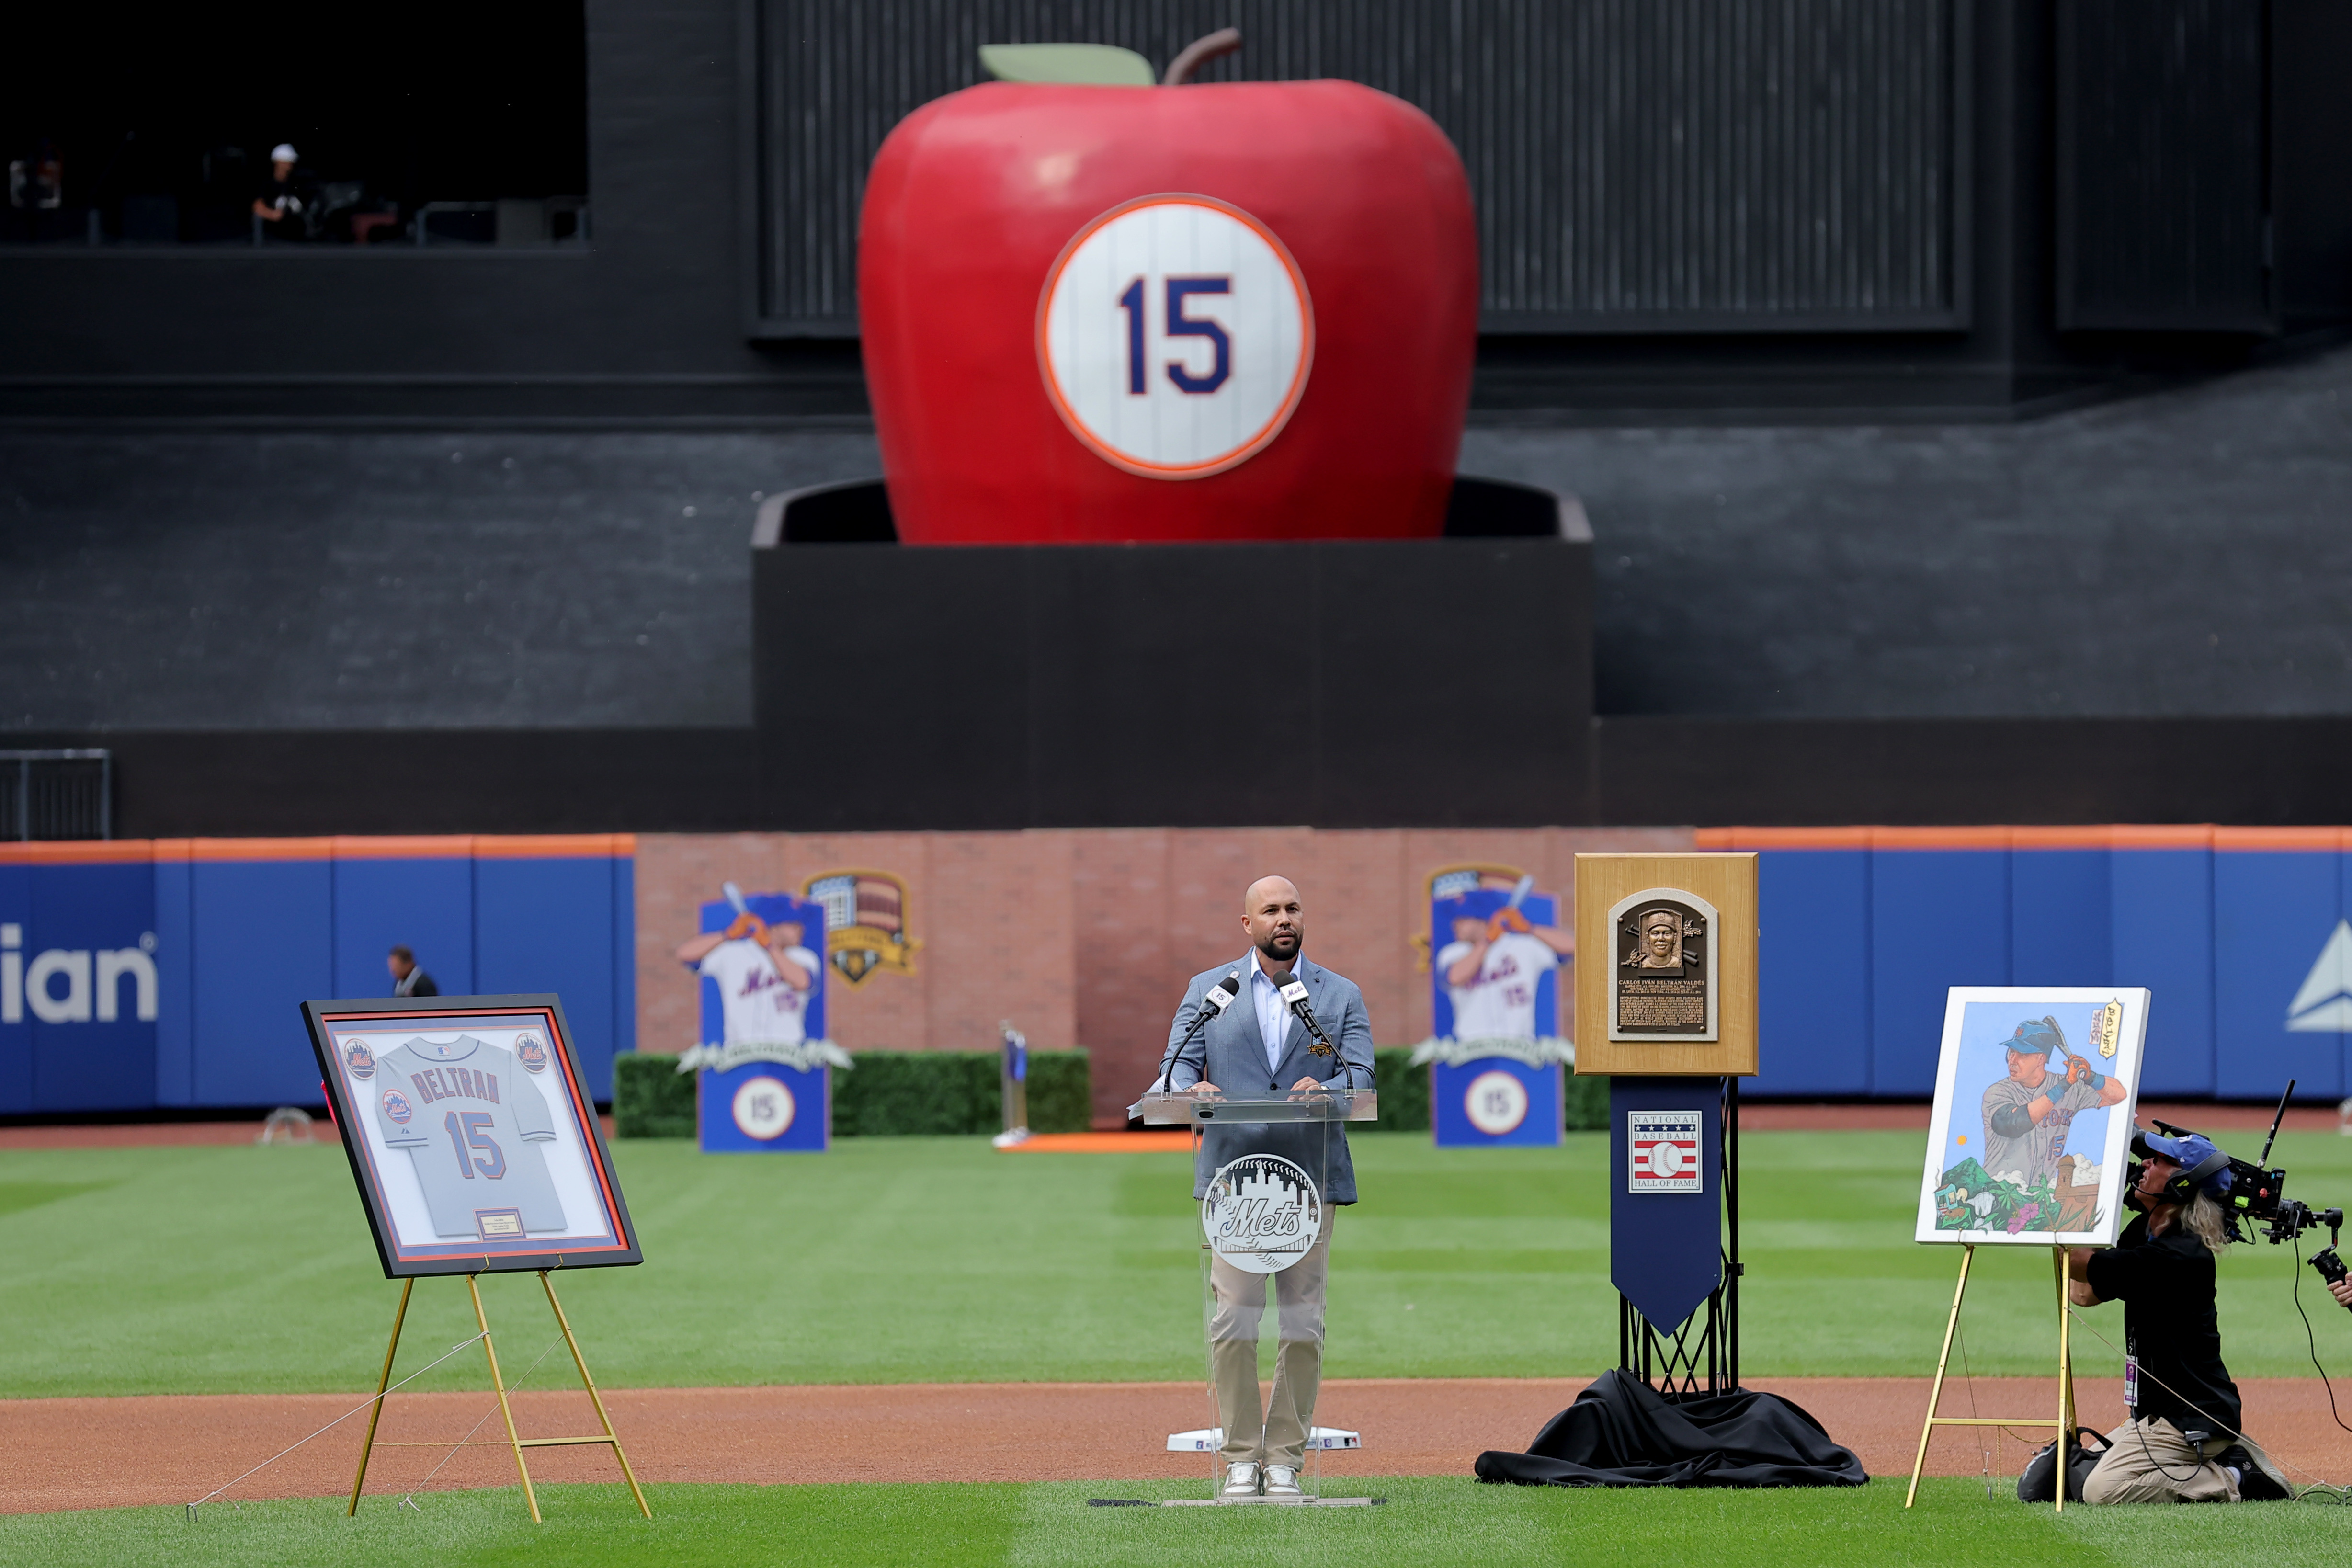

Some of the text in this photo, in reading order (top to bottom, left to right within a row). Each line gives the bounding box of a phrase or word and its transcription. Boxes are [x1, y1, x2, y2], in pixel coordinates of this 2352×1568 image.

[1117, 274, 1234, 397] 15
[1287, 986, 1304, 998] Mets
[410, 1067, 500, 1104] BELTRAN
[750, 1094, 777, 1122] 15
[1484, 1088, 1512, 1118] 15
[444, 1111, 507, 1180] 15
[2048, 1135, 2065, 1161] 15
[1220, 1198, 1302, 1238] Mets
